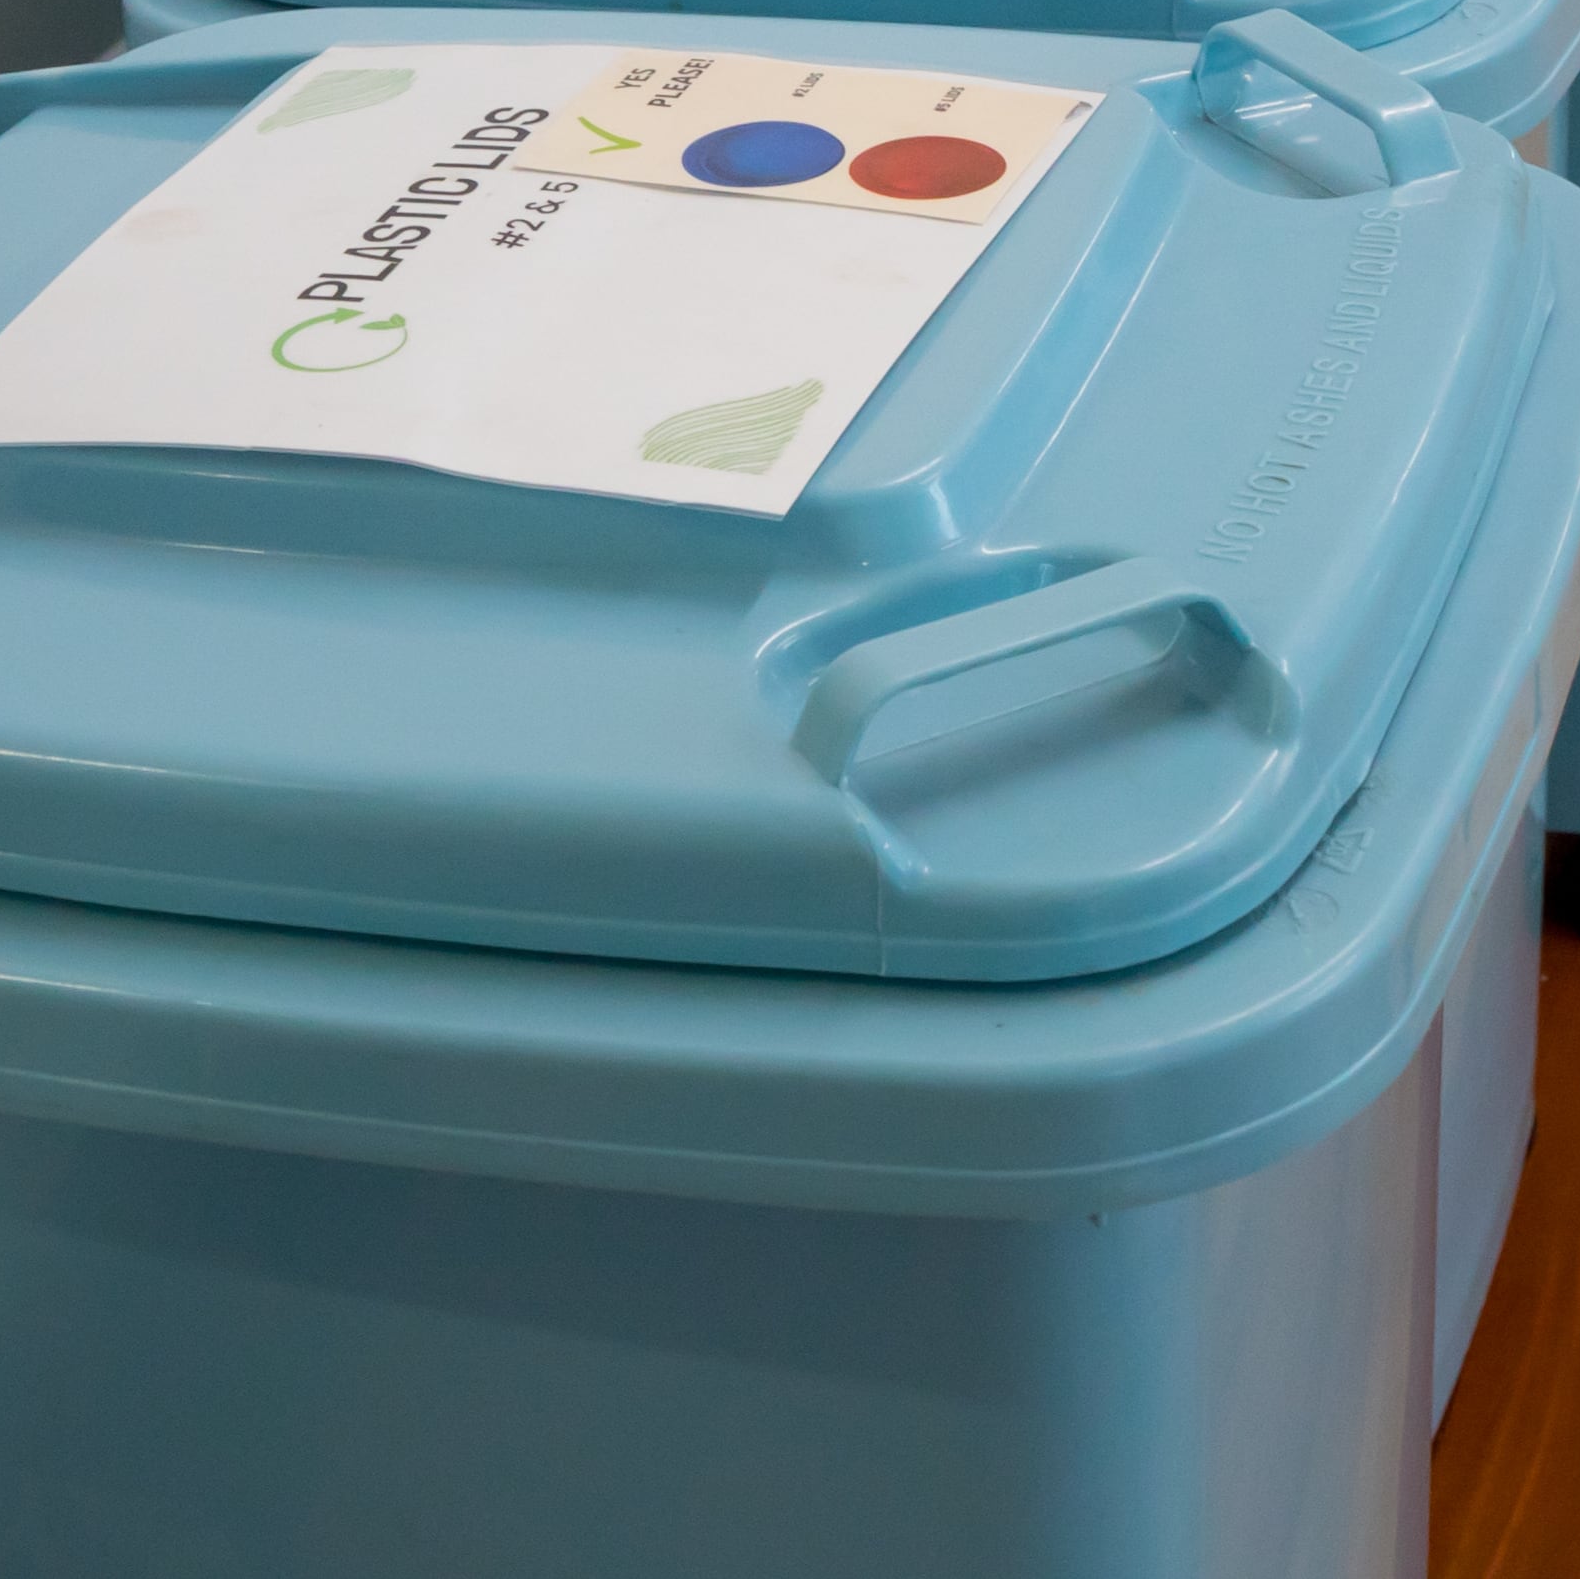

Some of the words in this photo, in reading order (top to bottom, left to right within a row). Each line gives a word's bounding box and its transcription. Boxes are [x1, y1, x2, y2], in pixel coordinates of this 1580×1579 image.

[614, 68, 657, 91] YES
[647, 58, 715, 108] PLEASE!
[799, 72, 825, 88] LIDS
[940, 86, 966, 102] LIDS
[296, 177, 479, 303] PLASTIC
[431, 107, 550, 171] LIDS
[524, 199, 566, 214] &
[539, 181, 580, 194] 5
[491, 218, 547, 249] #2
[1342, 206, 1406, 299] LIQUIDS
[1322, 299, 1381, 356] AND
[1277, 355, 1361, 451] ASHES
[1229, 450, 1311, 517] HOT
[1198, 519, 1267, 564] NO
